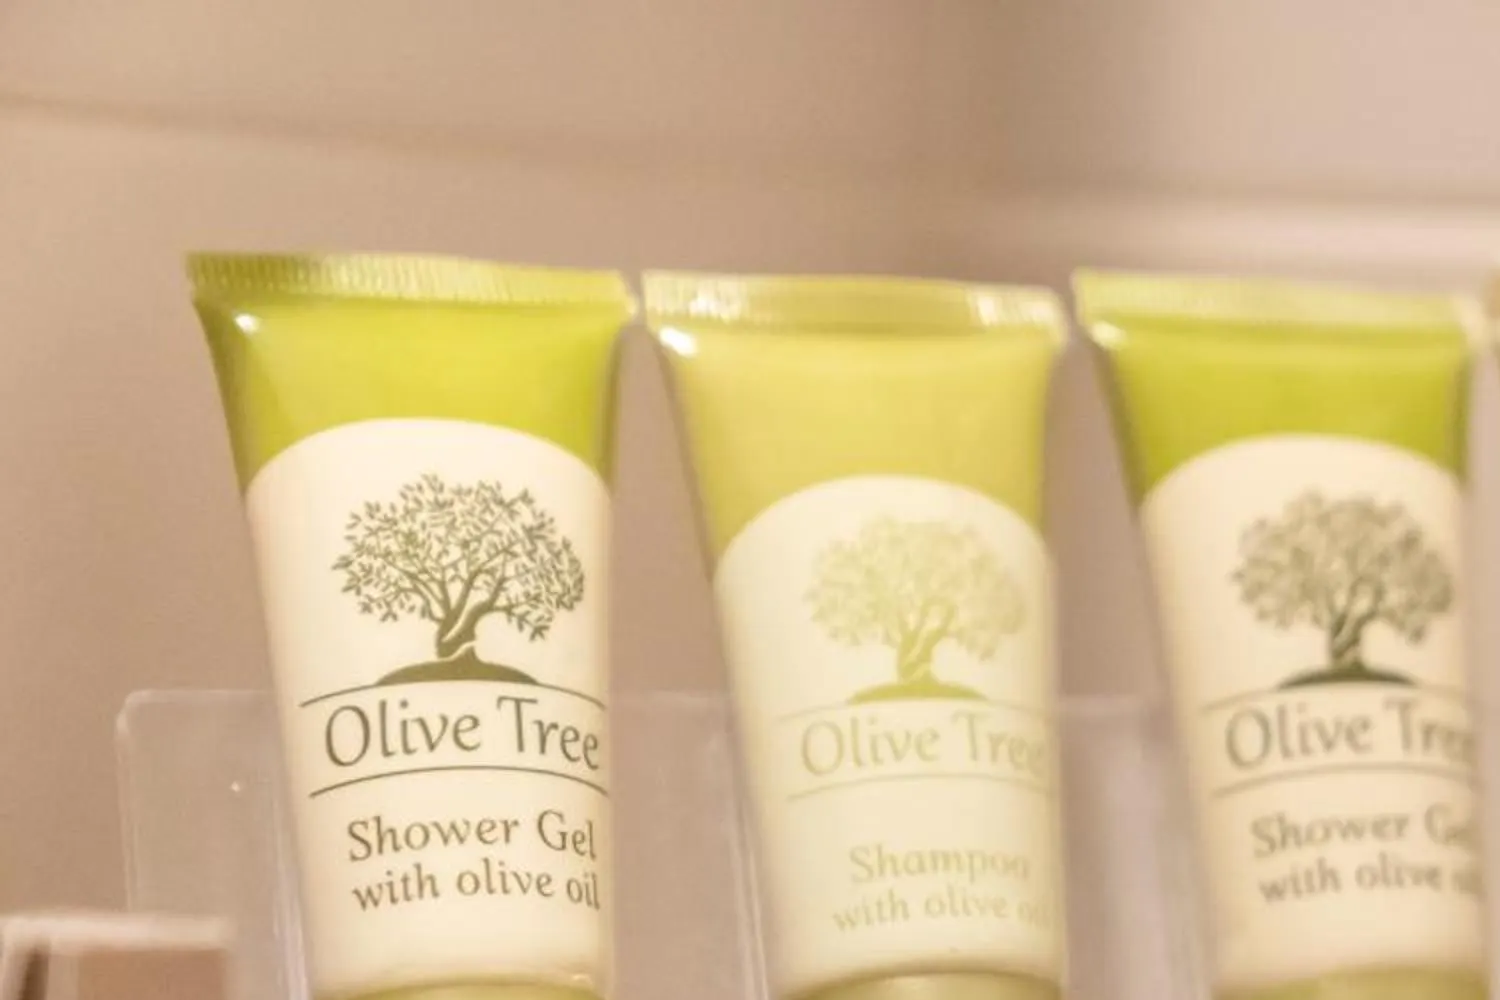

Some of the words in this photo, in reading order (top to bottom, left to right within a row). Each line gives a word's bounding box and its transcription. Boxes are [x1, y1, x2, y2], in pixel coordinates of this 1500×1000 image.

[324, 699, 482, 768] Olive
[496, 695, 600, 771] Tree
[800, 715, 941, 777] Olive
[1224, 701, 1375, 771] Olive
[346, 815, 520, 863] Shower
[536, 808, 597, 861] Gel
[1250, 810, 1410, 859] Shower
[351, 862, 440, 912] with
[456, 857, 555, 900] olive
[565, 872, 601, 912] oil
[848, 843, 1031, 883] Shampoo
[1258, 856, 1343, 903] with
[1353, 851, 1442, 891] olive
[831, 887, 911, 932] with
[923, 880, 1011, 920] olive
